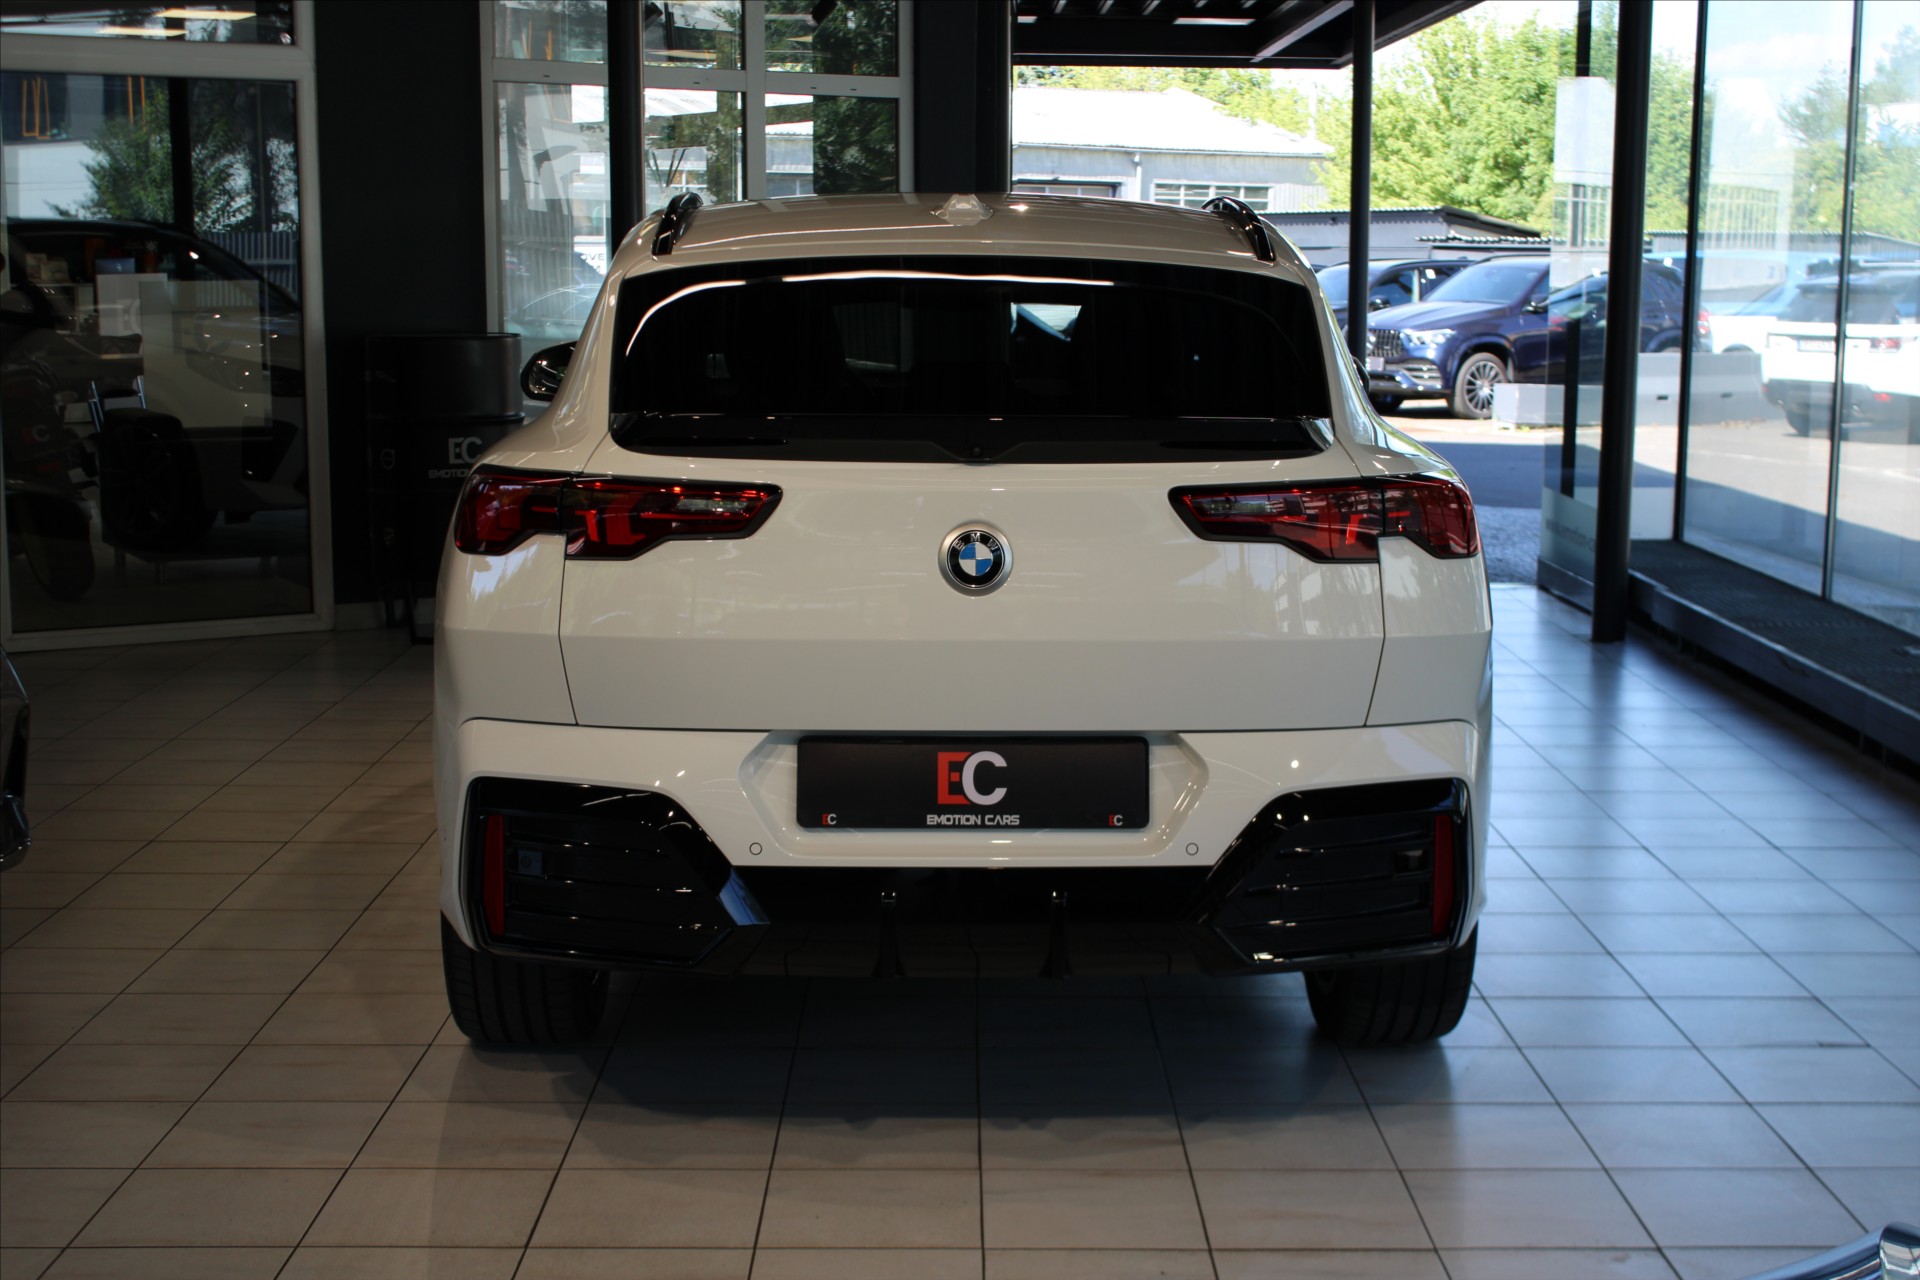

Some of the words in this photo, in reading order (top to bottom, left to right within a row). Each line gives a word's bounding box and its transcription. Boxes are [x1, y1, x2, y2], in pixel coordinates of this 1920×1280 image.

[448, 437, 483, 464] EC
[952, 532, 1000, 551] BMW
[936, 750, 1008, 805] EC
[821, 813, 837, 825] EC
[926, 814, 982, 826] EMOTION
[984, 814, 1020, 826] CARS
[1108, 814, 1123, 826] EC
